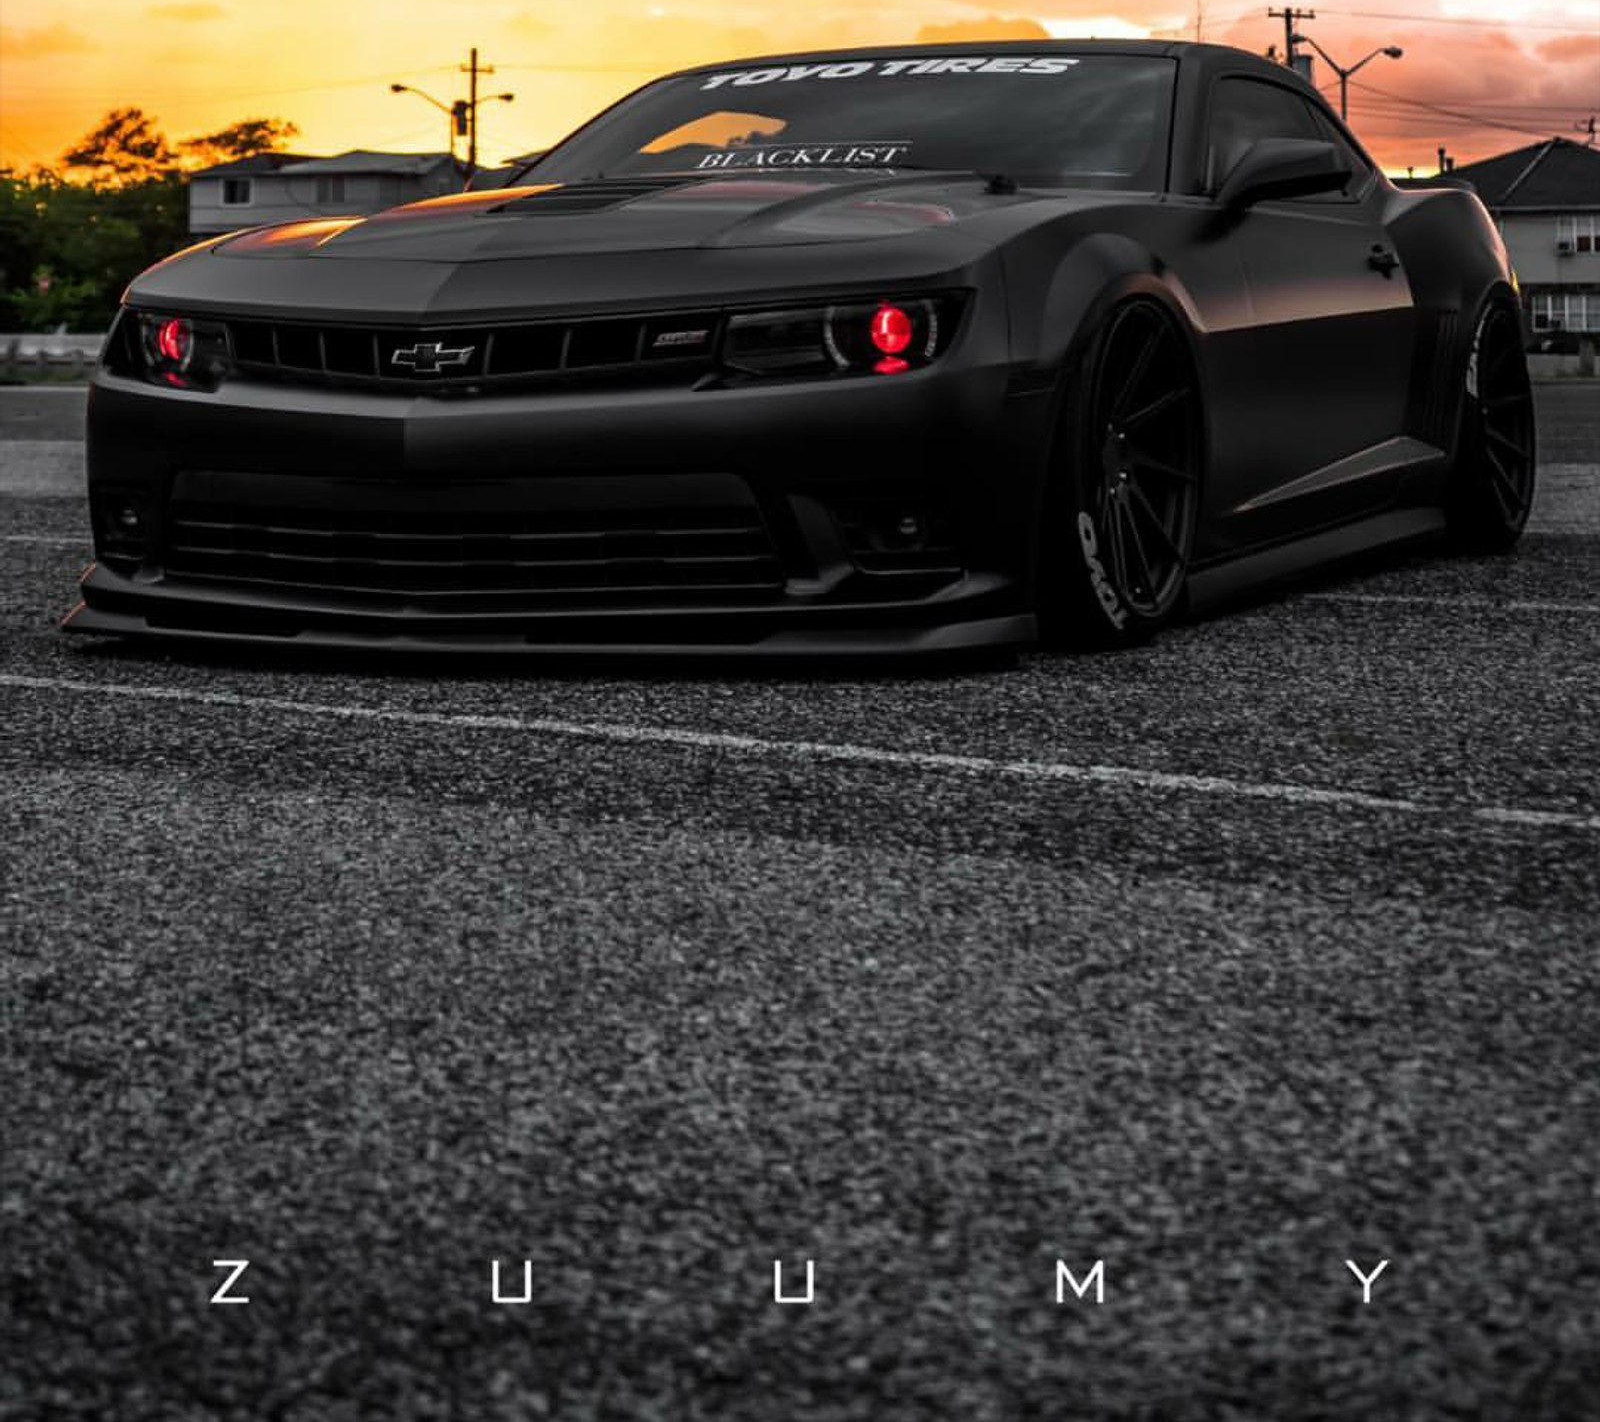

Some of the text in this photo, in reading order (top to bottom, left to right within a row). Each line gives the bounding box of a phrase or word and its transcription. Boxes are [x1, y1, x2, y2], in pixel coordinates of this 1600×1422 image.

[700, 57, 1080, 90] TOYO TIRES
[697, 146, 904, 169] BLACKLIST
